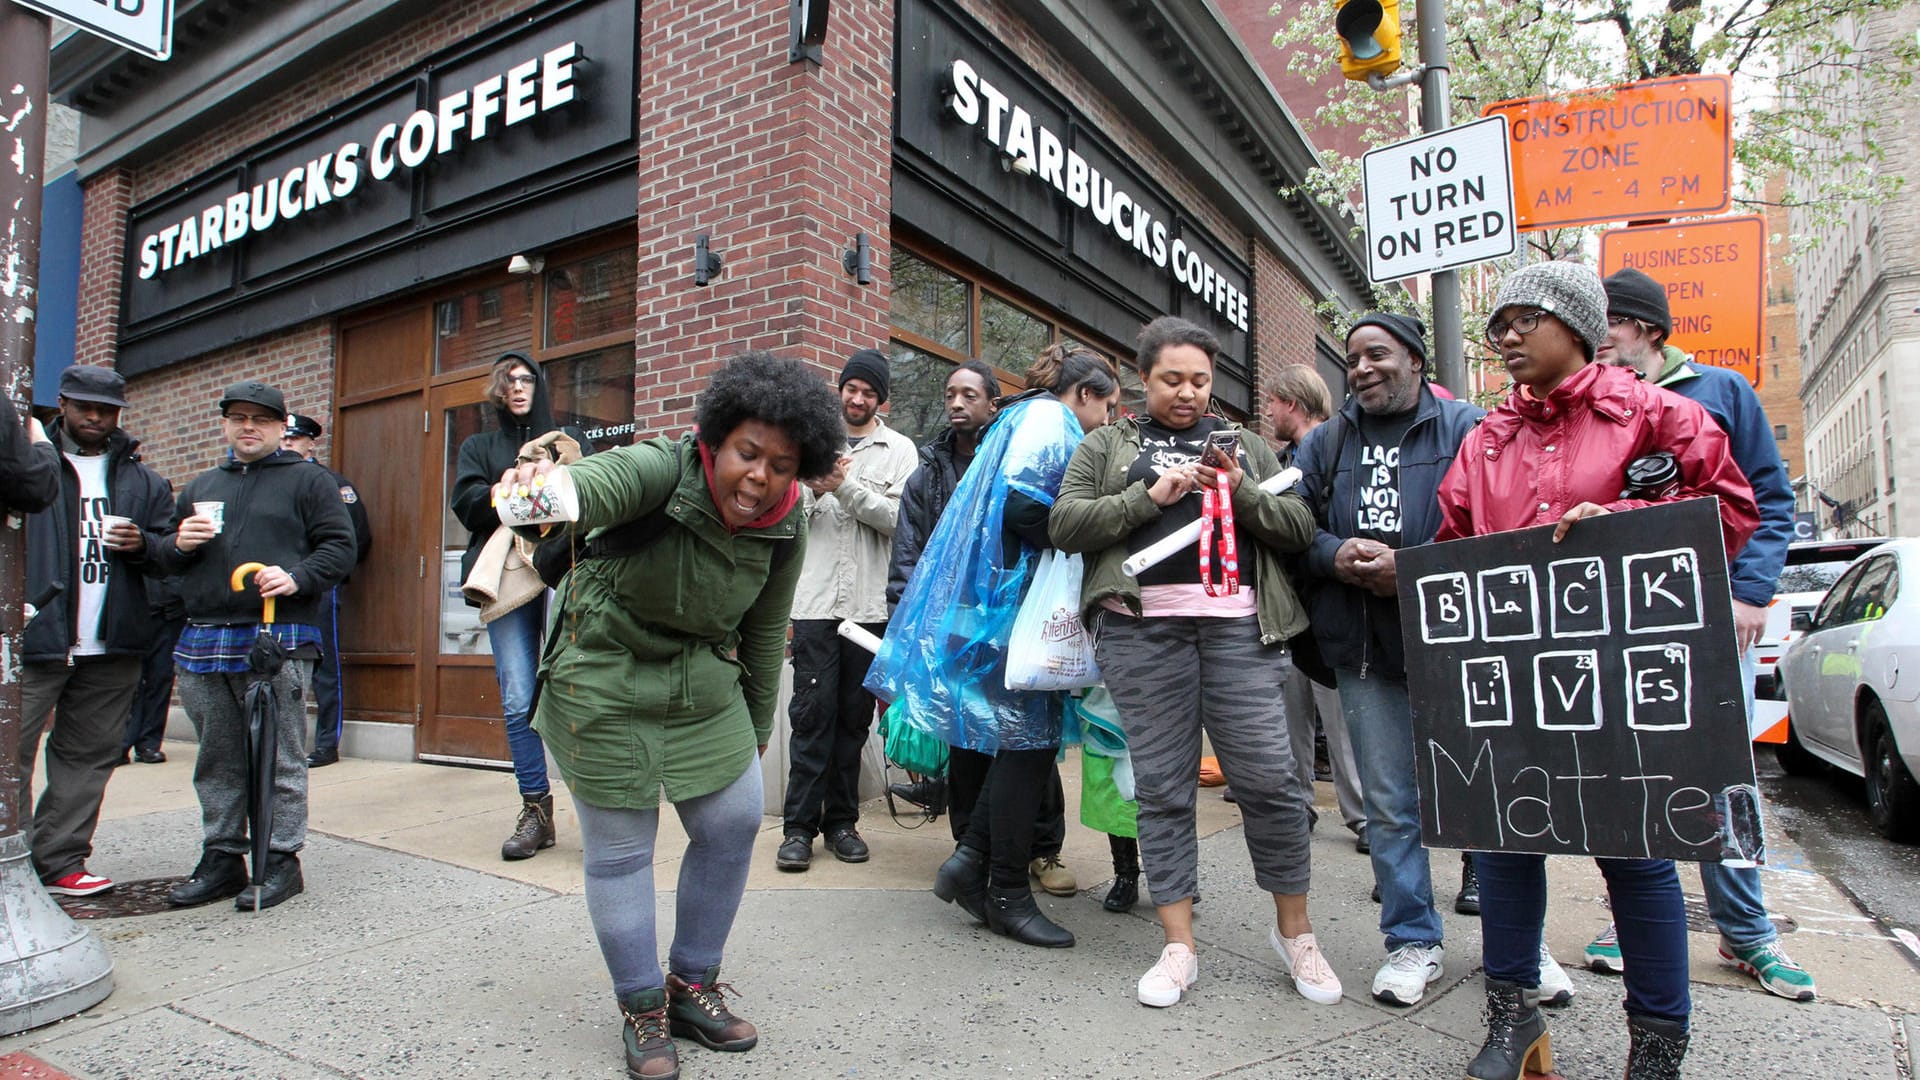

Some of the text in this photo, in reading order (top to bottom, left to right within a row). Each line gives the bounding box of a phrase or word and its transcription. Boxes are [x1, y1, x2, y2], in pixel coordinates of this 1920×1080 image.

[1508, 96, 1718, 142] ONSTRUCTION
[138, 40, 577, 281] STARBUCKS COFFEE
[1410, 146, 1457, 181] NO
[1561, 142, 1640, 174] ZONE
[951, 58, 1249, 333] STARBUCKS COFFEE
[1389, 175, 1485, 221] TURN
[1535, 186, 1573, 208] AM
[1624, 179, 1640, 198] 4
[1661, 174, 1700, 195] PM
[1377, 210, 1505, 261] ON RED
[1622, 243, 1740, 270] BUSINESSES
[1664, 281, 1704, 300] PEN
[1690, 347, 1751, 367] CTION
[583, 423, 636, 440] CKS COFFE
[1361, 444, 1400, 468] LAC
[1370, 464, 1391, 487] IS
[1360, 486, 1400, 508] NOT
[1451, 577, 1465, 596] 5
[1584, 562, 1599, 579] 6
[1672, 555, 1691, 573] 19
[1438, 571, 1686, 623] B La C K
[1491, 663, 1501, 680] 3
[1575, 656, 1593, 669] 23
[1472, 681, 1496, 706] Li
[1551, 673, 1588, 712] V
[1428, 731, 1766, 865] Matter
